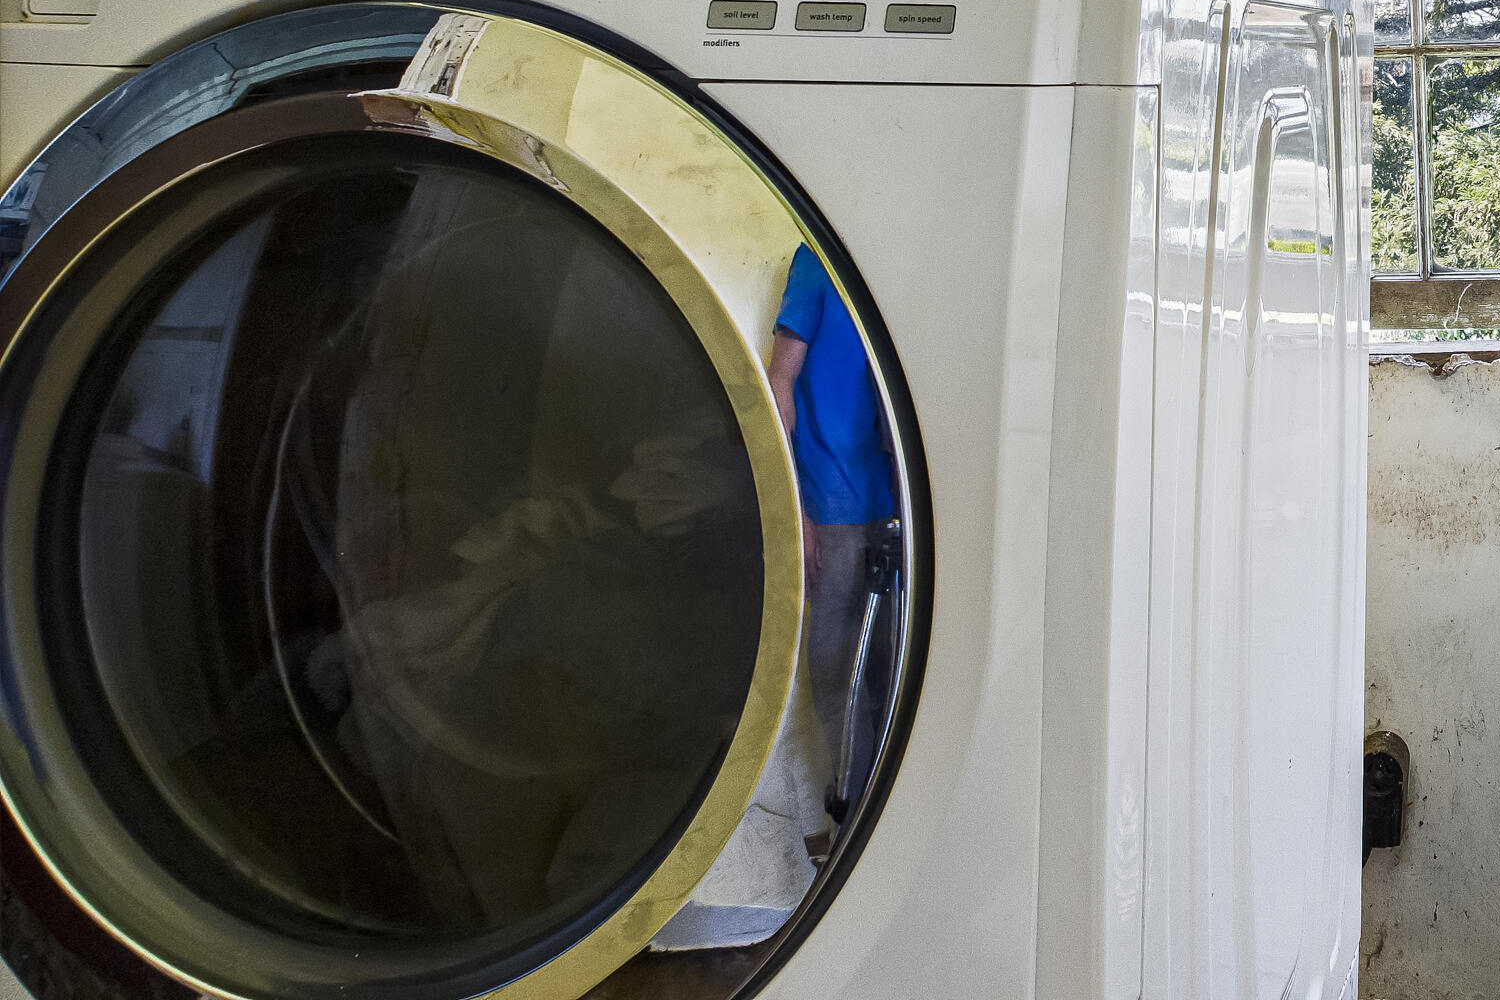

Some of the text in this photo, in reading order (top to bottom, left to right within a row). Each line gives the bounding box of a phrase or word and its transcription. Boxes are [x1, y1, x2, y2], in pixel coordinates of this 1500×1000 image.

[723, 10, 759, 19] soil level
[810, 13, 853, 23] wash temp
[899, 15, 941, 24] spin speed
[703, 39, 740, 47] modifiers
